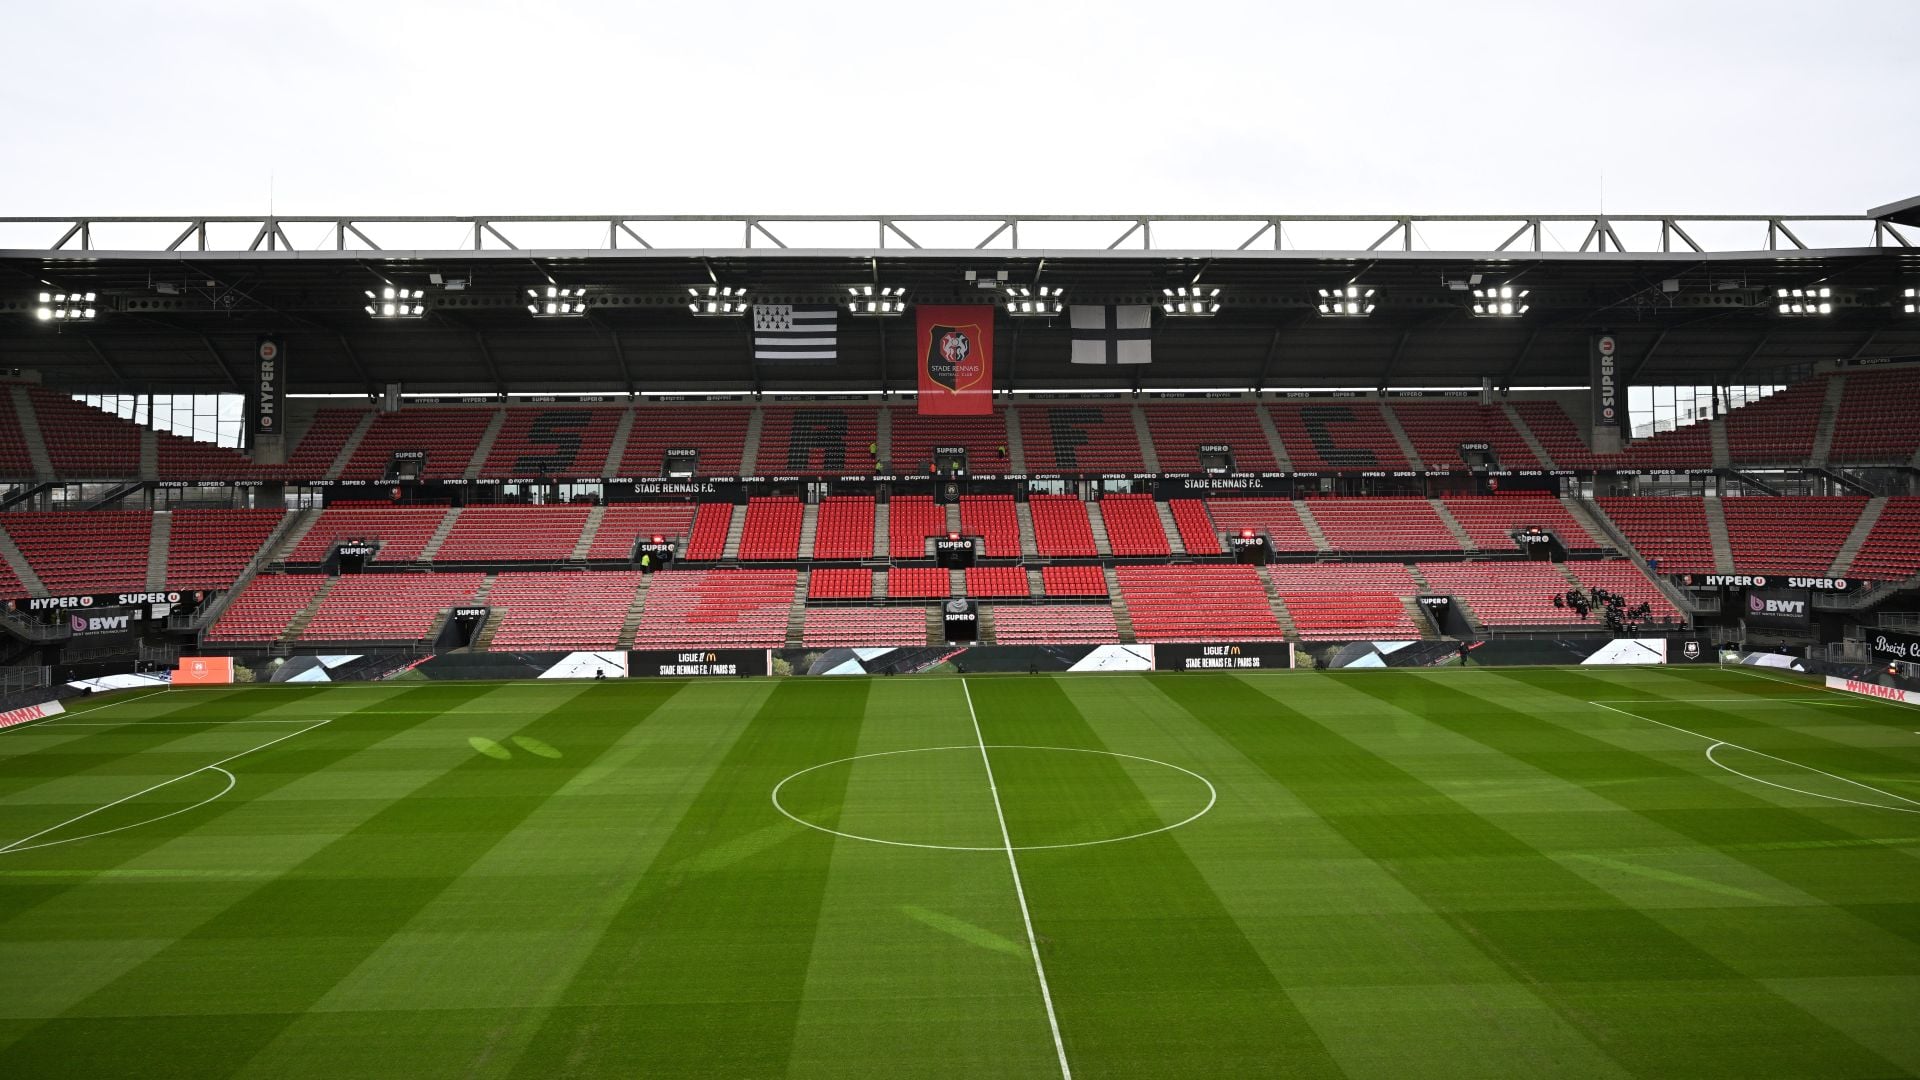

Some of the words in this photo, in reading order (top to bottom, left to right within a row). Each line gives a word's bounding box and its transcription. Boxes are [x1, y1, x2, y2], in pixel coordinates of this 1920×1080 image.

[261, 360, 274, 414] HYPER
[1601, 355, 1614, 406] SUPER
[635, 483, 660, 493] STADE
[663, 483, 699, 493] RENNAIS
[701, 483, 716, 493] F.C.
[1184, 479, 1209, 488] STADE
[1211, 479, 1247, 488] RENNAIS
[1249, 479, 1263, 488] F.C.
[1706, 575, 1752, 586] HYPER
[1788, 577, 1832, 588] SUPER
[30, 596, 78, 609] HYPER
[118, 593, 165, 604] SUPER
[1766, 599, 1804, 613] BWT
[89, 615, 128, 630] BWT
[1203, 646, 1223, 655] LIGUE
[1874, 635, 1906, 657] Breizh
[678, 653, 698, 662] LIGUE
[1185, 658, 1201, 668] STADE
[1202, 658, 1224, 668] RENNAIS
[1237, 657, 1252, 667] PARIS
[1253, 657, 1260, 667] SG
[659, 665, 676, 675] STADE
[676, 665, 699, 675] RENNAIS
[713, 664, 728, 674] PARIS
[729, 664, 736, 674] SG
[1846, 679, 1905, 701] WINAMAX
